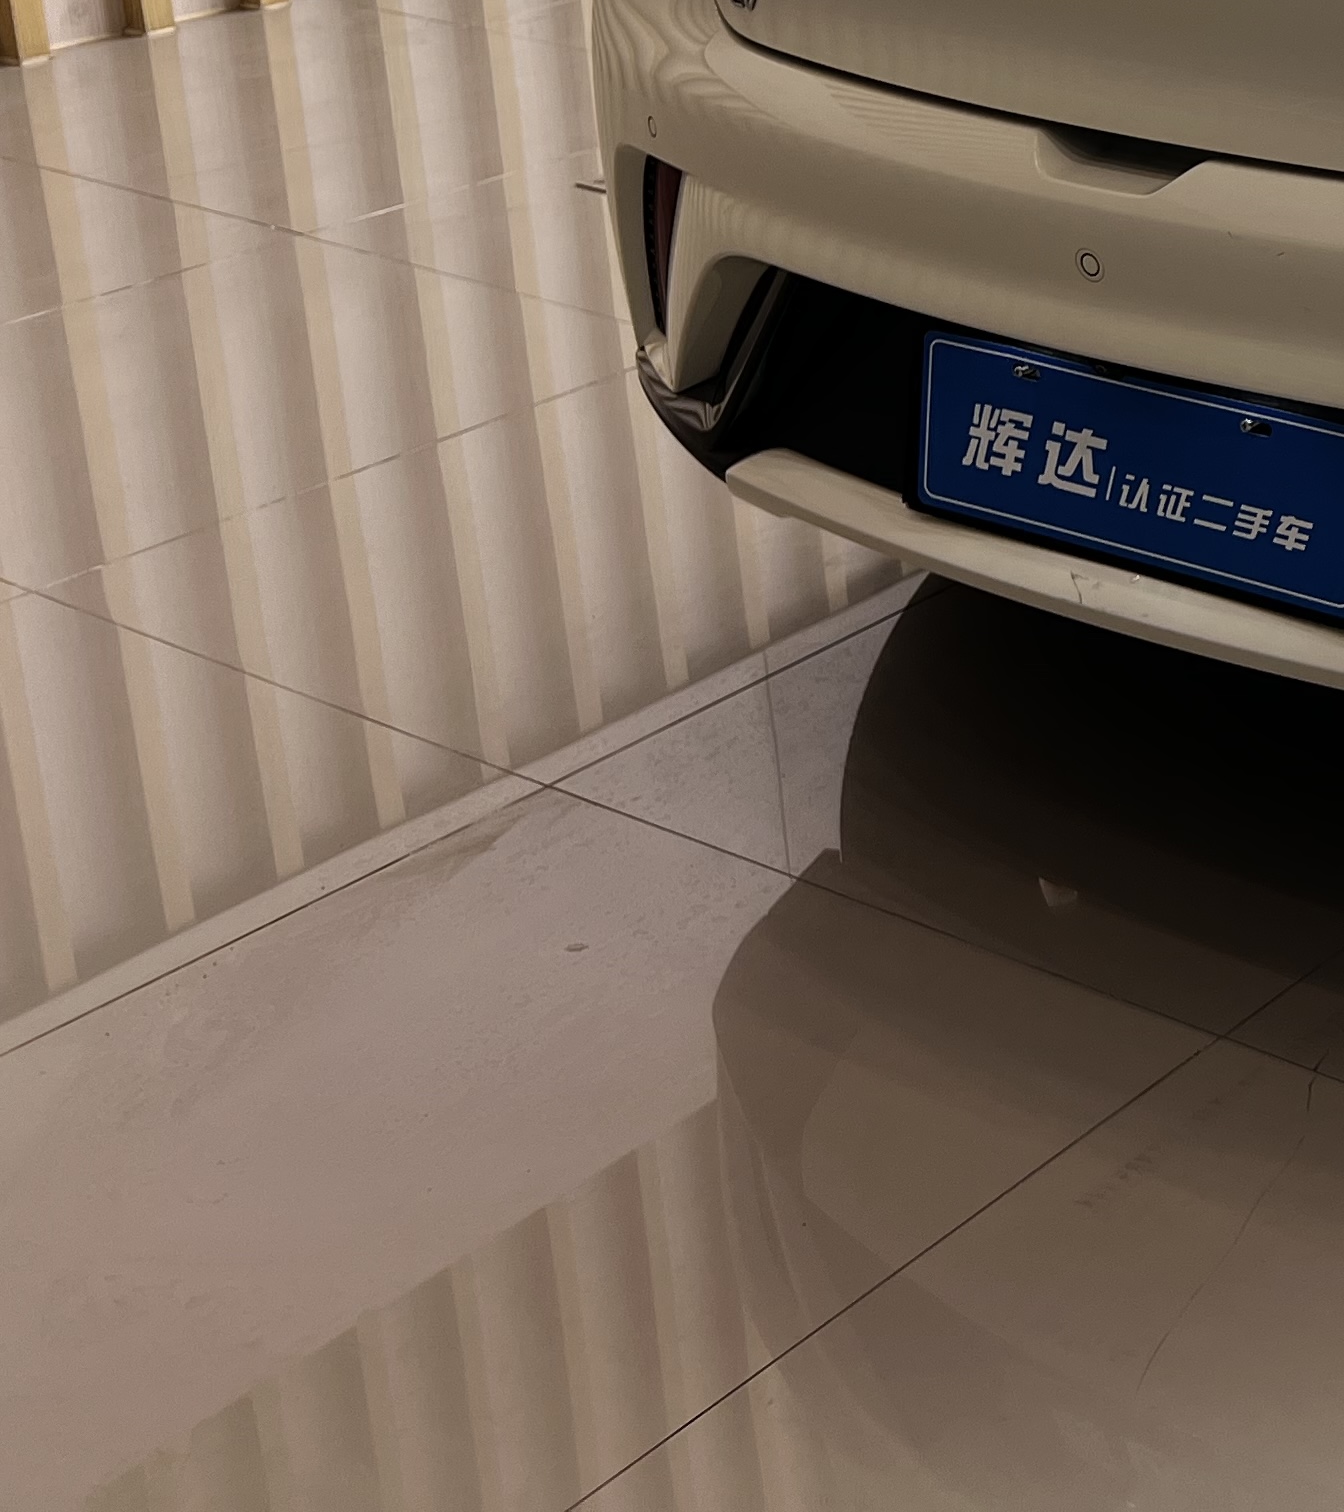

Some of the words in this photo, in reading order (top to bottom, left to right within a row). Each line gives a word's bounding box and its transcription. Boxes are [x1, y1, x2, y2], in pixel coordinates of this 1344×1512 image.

[962, 403, 1108, 499] 辉达
[1119, 473, 1315, 552] 认证二手车
